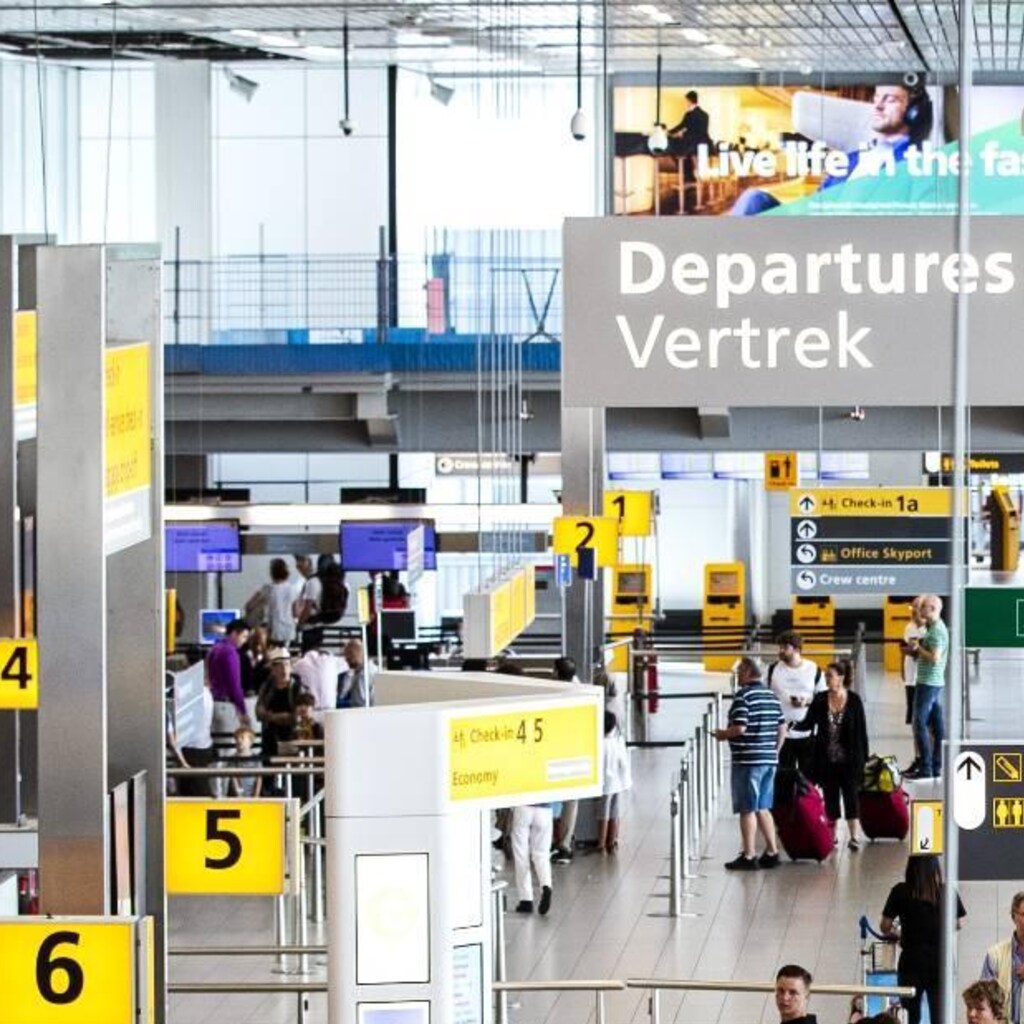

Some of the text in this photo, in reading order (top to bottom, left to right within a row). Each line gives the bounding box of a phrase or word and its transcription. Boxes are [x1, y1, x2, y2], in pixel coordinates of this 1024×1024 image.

[697, 141, 776, 178] Live
[785, 140, 850, 178] life
[903, 140, 970, 177] the
[618, 240, 1016, 309] Departures
[616, 310, 874, 369] Vertrek
[612, 495, 625, 517] 1
[841, 494, 919, 512] Check-in 1a
[575, 521, 595, 552] 2
[840, 546, 933, 562] Office Skyport
[819, 573, 896, 586] Crew centre
[1, 647, 33, 689] 4
[470, 717, 544, 744] Check-in 4 5
[451, 768, 499, 787] Economy
[204, 808, 243, 870] 5
[35, 931, 84, 1005] 6
